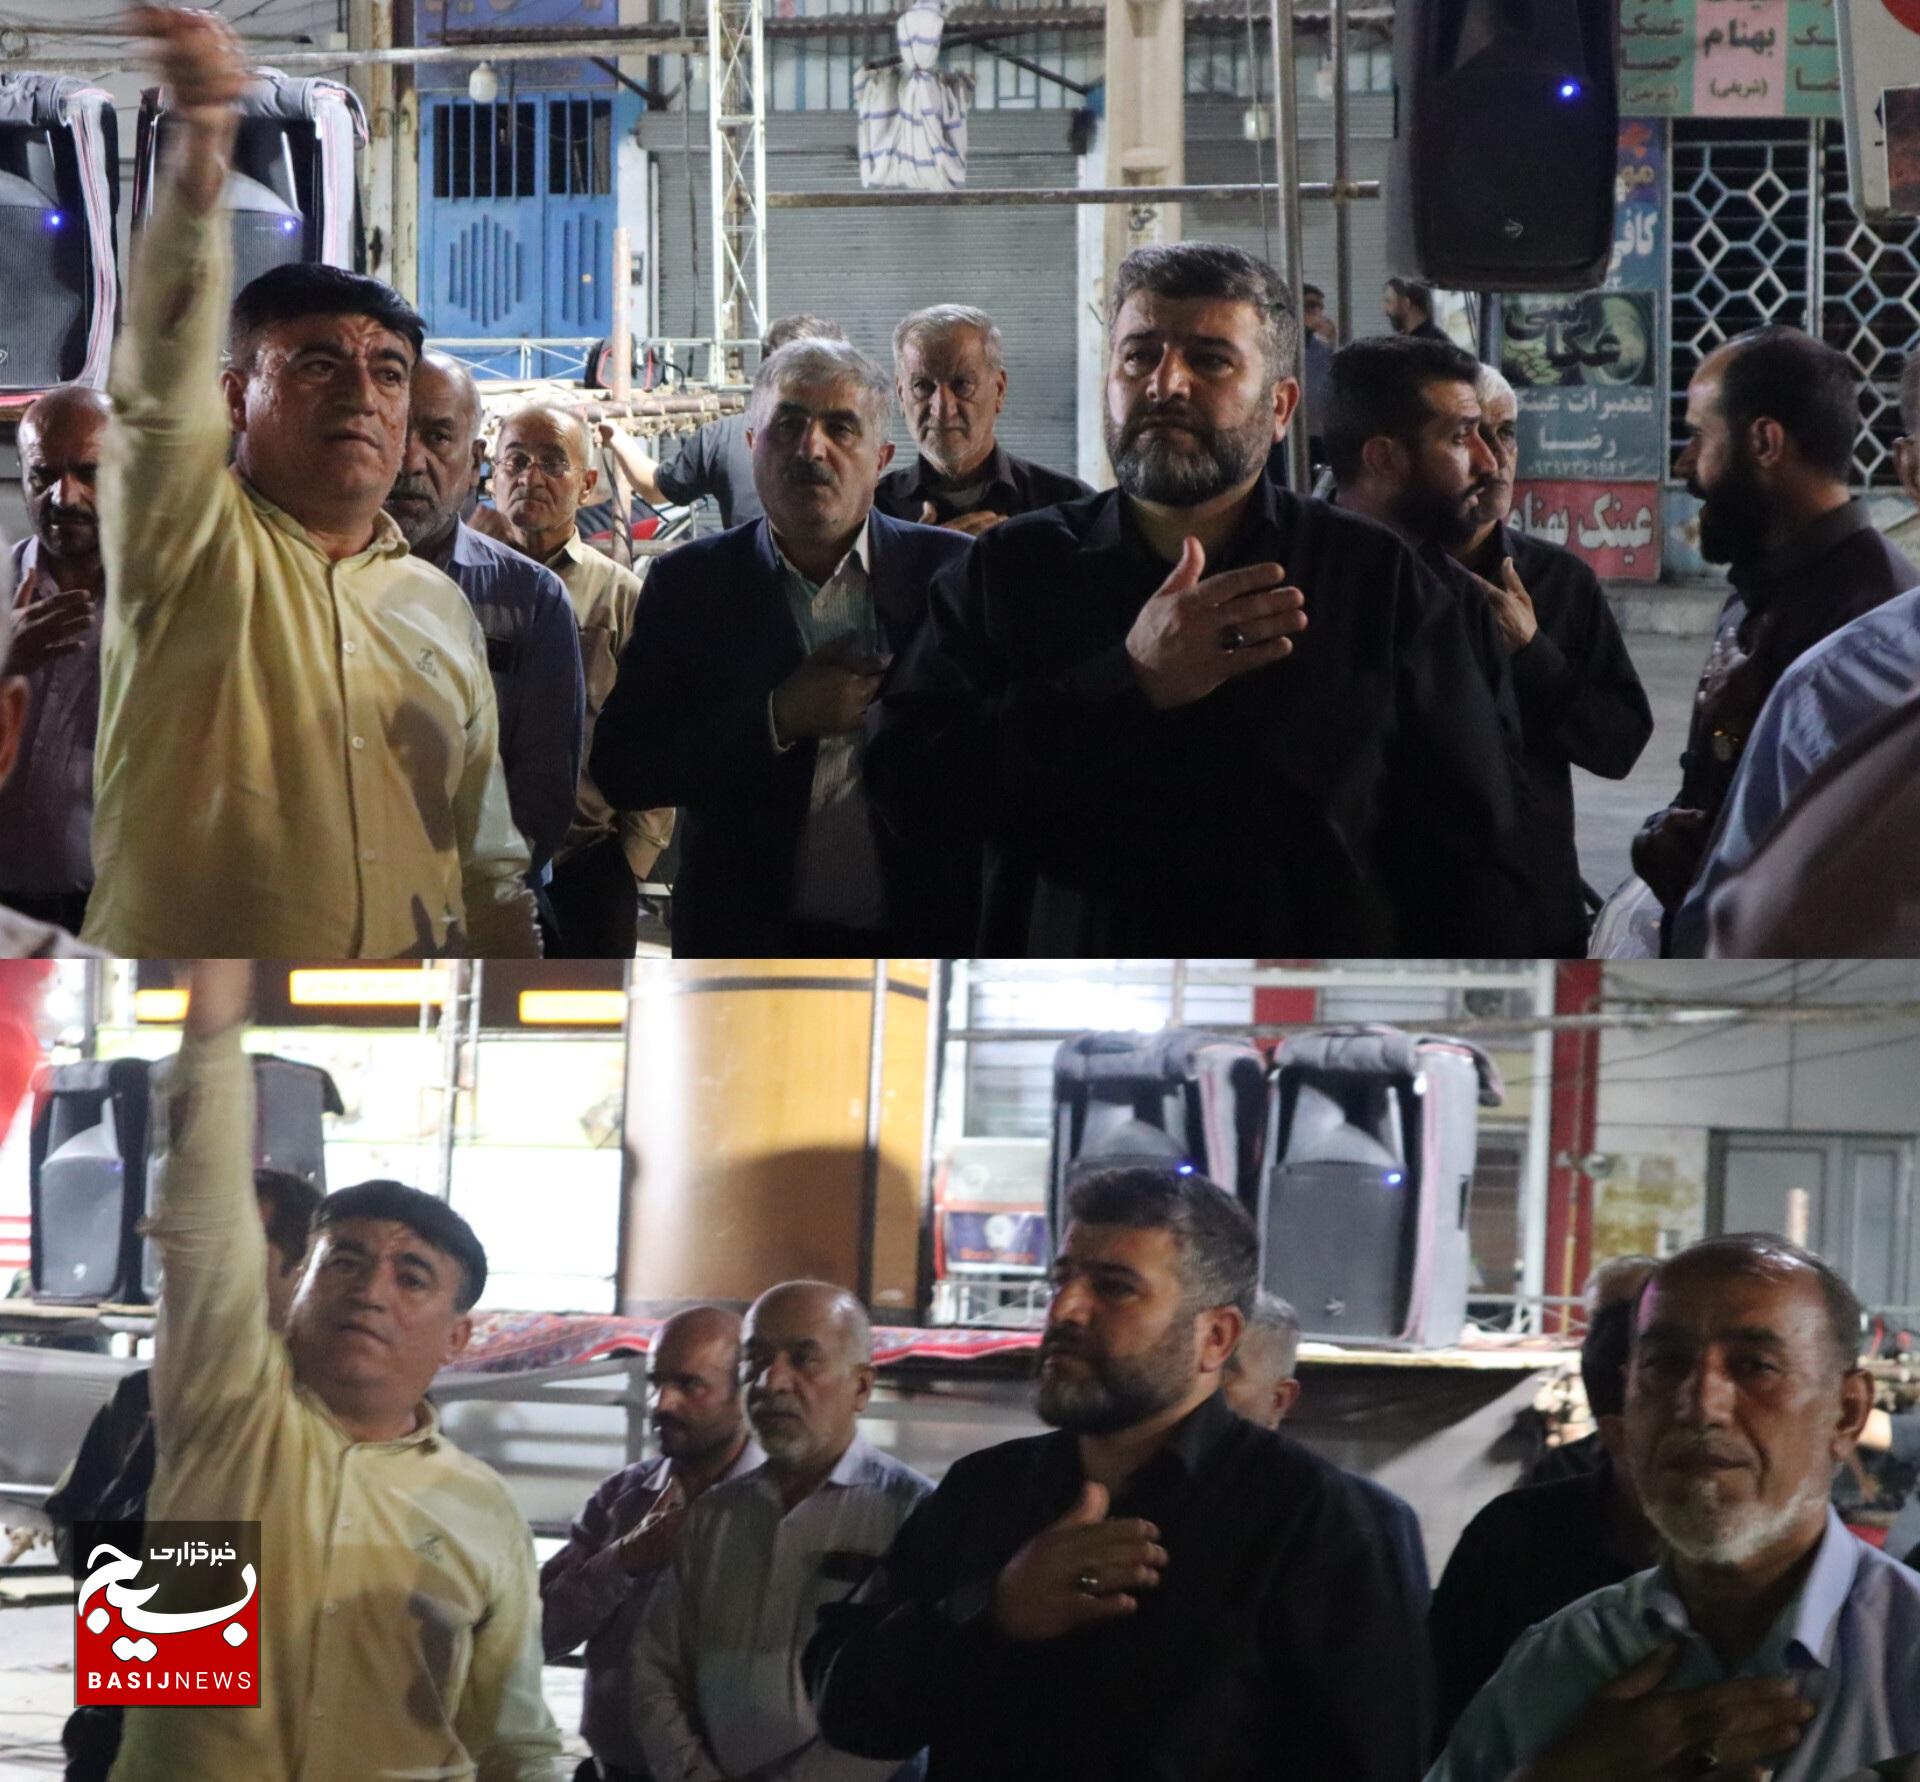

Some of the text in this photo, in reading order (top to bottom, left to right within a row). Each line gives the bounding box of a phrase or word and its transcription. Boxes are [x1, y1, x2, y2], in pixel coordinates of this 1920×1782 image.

[1703, 17, 1776, 58] بهنام
[1568, 388, 1654, 420] تعمیرات
[1539, 426, 1618, 458] رضا
[1577, 491, 1653, 566] عینک
